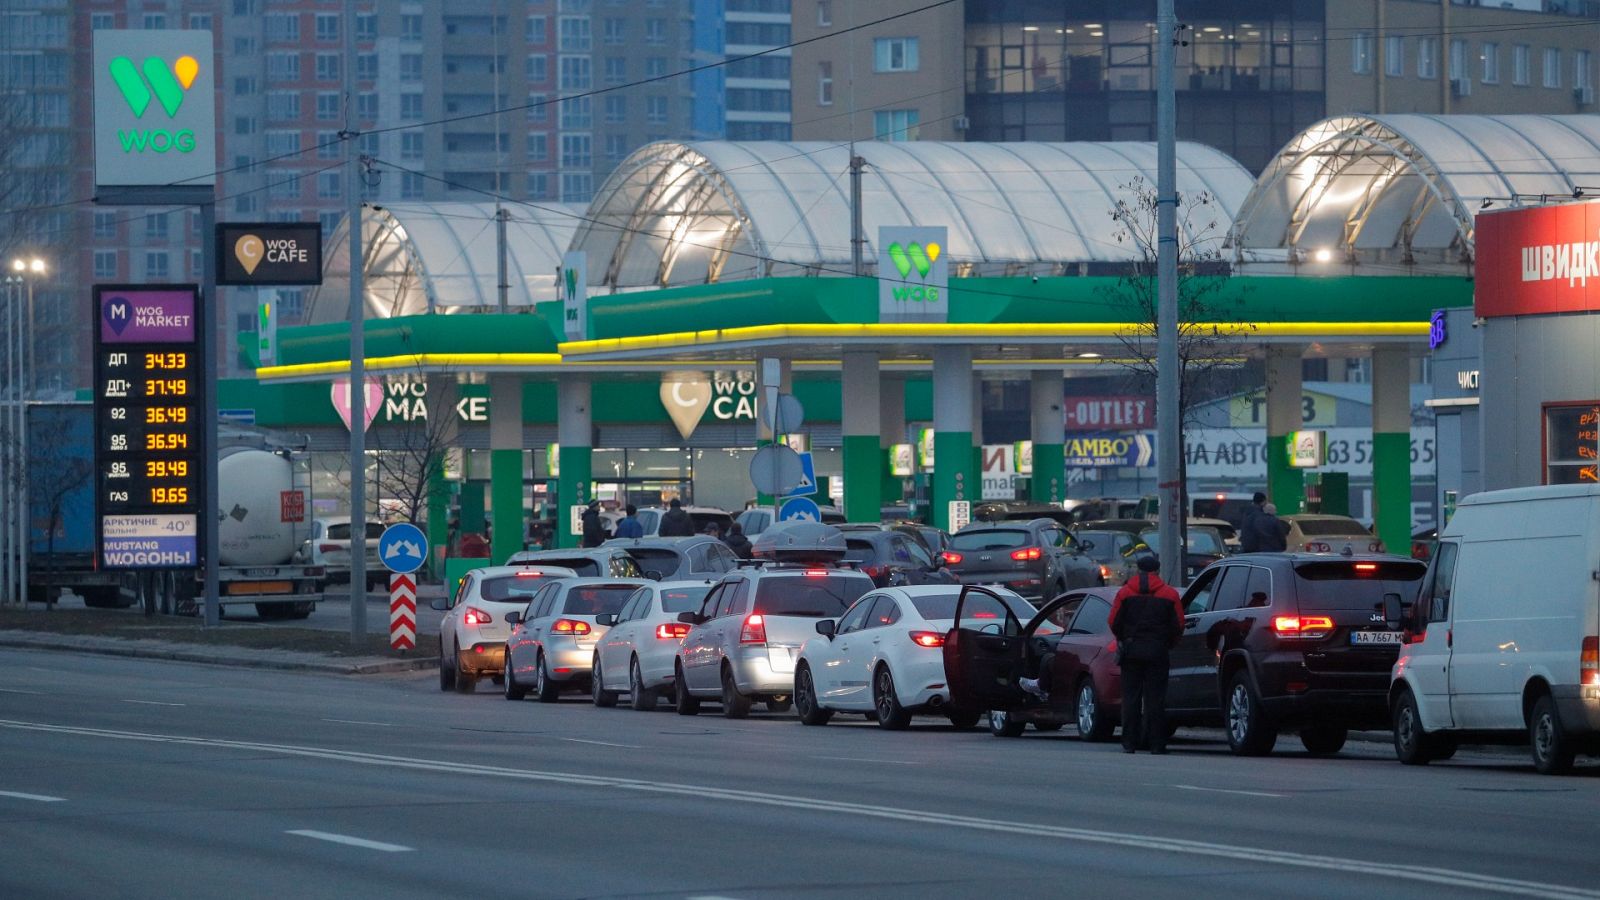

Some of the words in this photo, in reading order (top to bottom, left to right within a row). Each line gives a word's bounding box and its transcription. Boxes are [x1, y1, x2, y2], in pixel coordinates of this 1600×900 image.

[117, 128, 196, 153] WOG
[266, 240, 297, 250] WOG
[266, 249, 308, 263] CAFE
[1521, 241, 1600, 288] ШВИДК
[892, 287, 939, 302] WOG
[111, 303, 126, 319] M
[135, 306, 163, 316] WOG
[135, 315, 190, 327] MARKET
[108, 353, 127, 367] ДП
[145, 353, 186, 369] 34.33
[106, 379, 132, 392] ДП+
[145, 379, 186, 395] 37.49
[386, 381, 427, 397] WO
[714, 380, 755, 395] WO
[111, 408, 126, 419] 92
[146, 407, 187, 423] 36.49
[386, 397, 492, 421] MAKE
[713, 396, 758, 419] CA
[1064, 401, 1146, 425] -OUTLET
[111, 435, 126, 446] 95
[146, 434, 187, 450] 36.94
[111, 462, 127, 474] 95
[146, 461, 187, 477] 39.49
[109, 491, 128, 502] ГАЗ
[151, 488, 188, 503] 19.65
[104, 518, 158, 526] АРКТИЧНЕ
[104, 541, 158, 550] MUSTANG
[1357, 633, 1369, 642] AA
[1371, 633, 1391, 642] 7667
